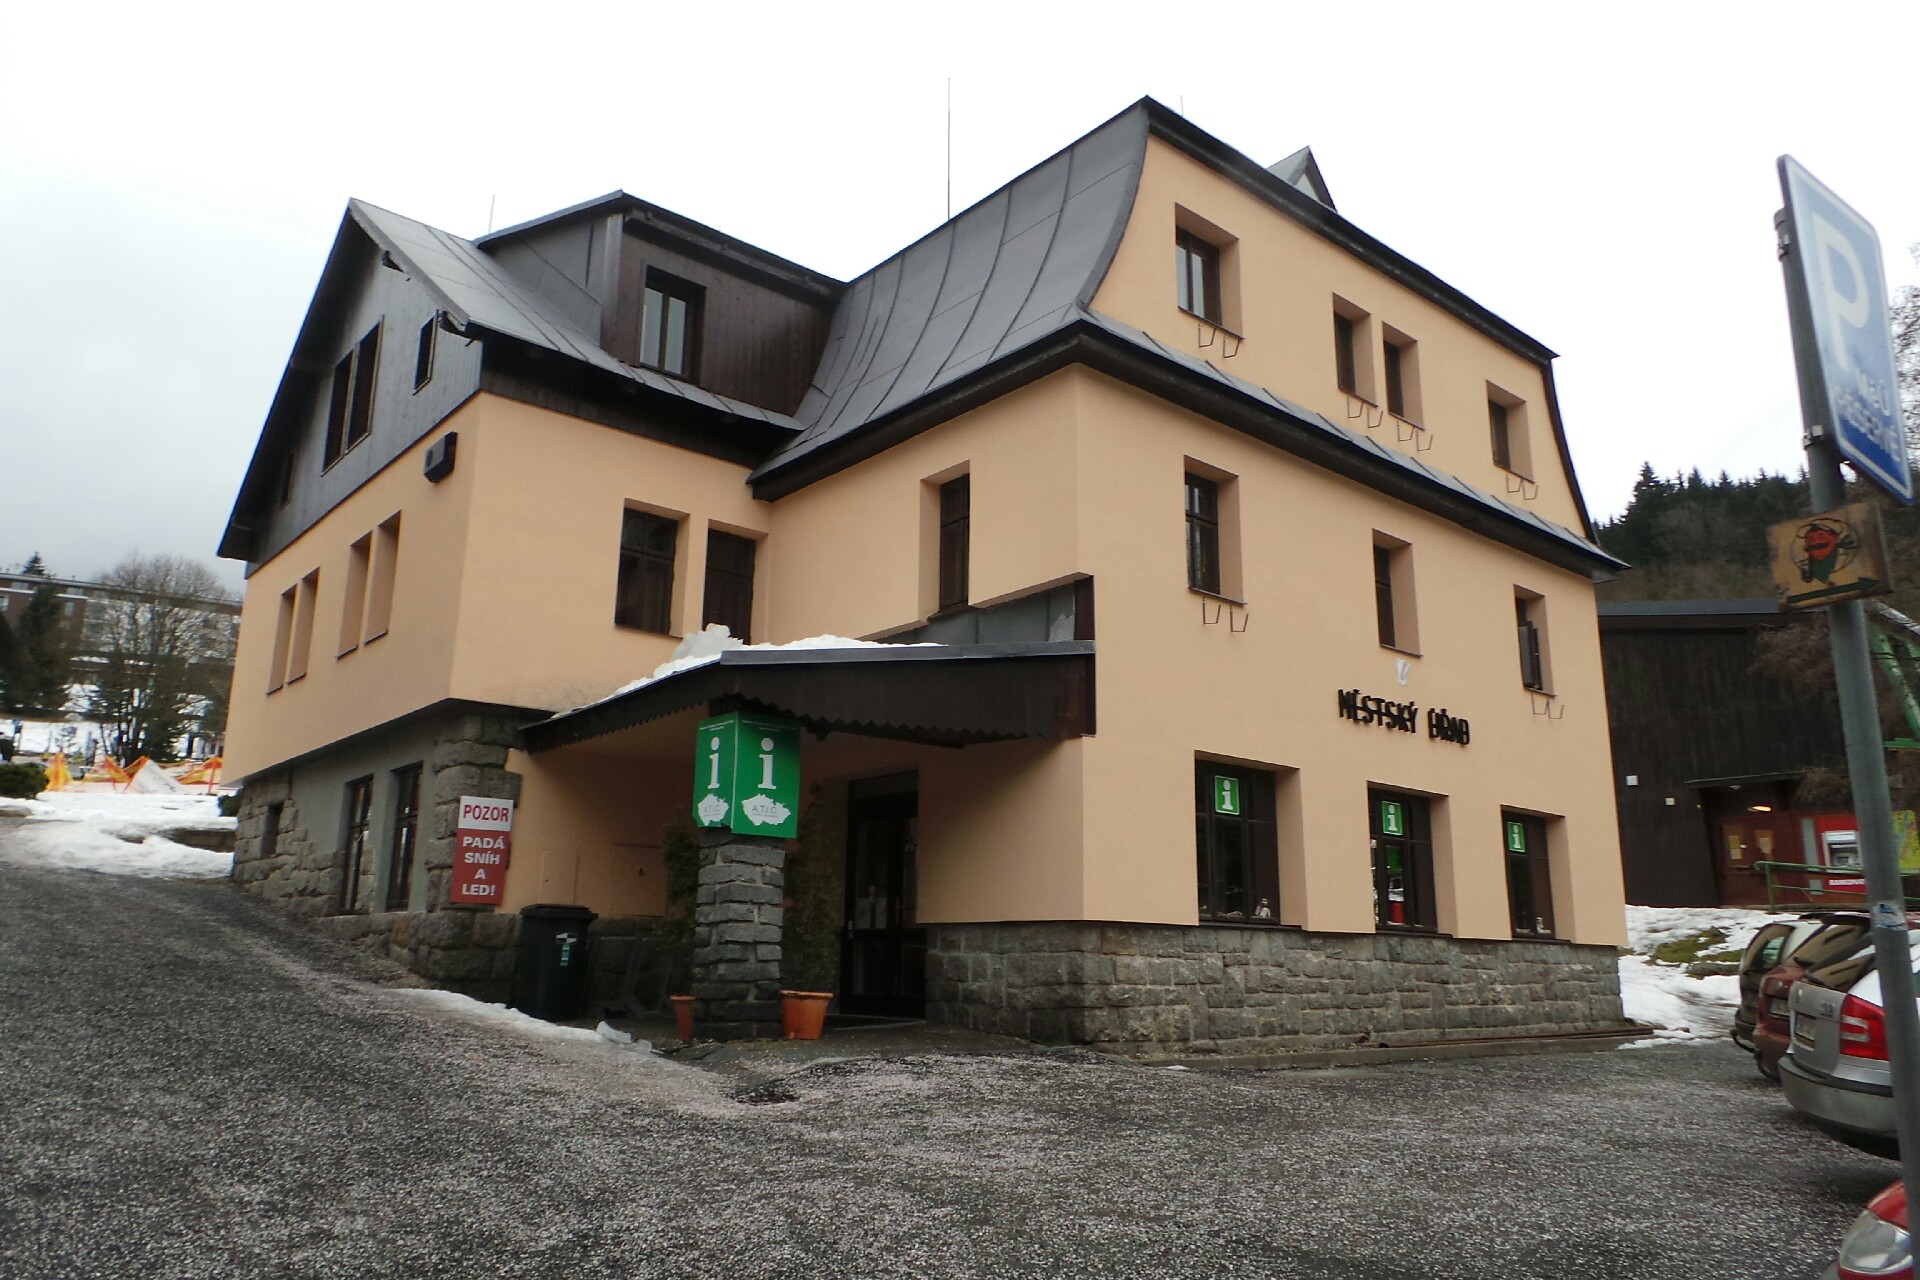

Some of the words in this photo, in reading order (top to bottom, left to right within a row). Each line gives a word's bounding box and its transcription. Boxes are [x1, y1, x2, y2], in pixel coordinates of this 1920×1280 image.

[1811, 211, 1870, 372] P
[1337, 688, 1419, 734] MĚSTSKÝ
[1427, 707, 1471, 746] ÚŘAD
[463, 804, 510, 822] POZOR
[462, 836, 505, 850] PADÁ
[464, 851, 501, 865] SNÍH
[474, 868, 487, 880] A
[462, 883, 496, 896] LED!
